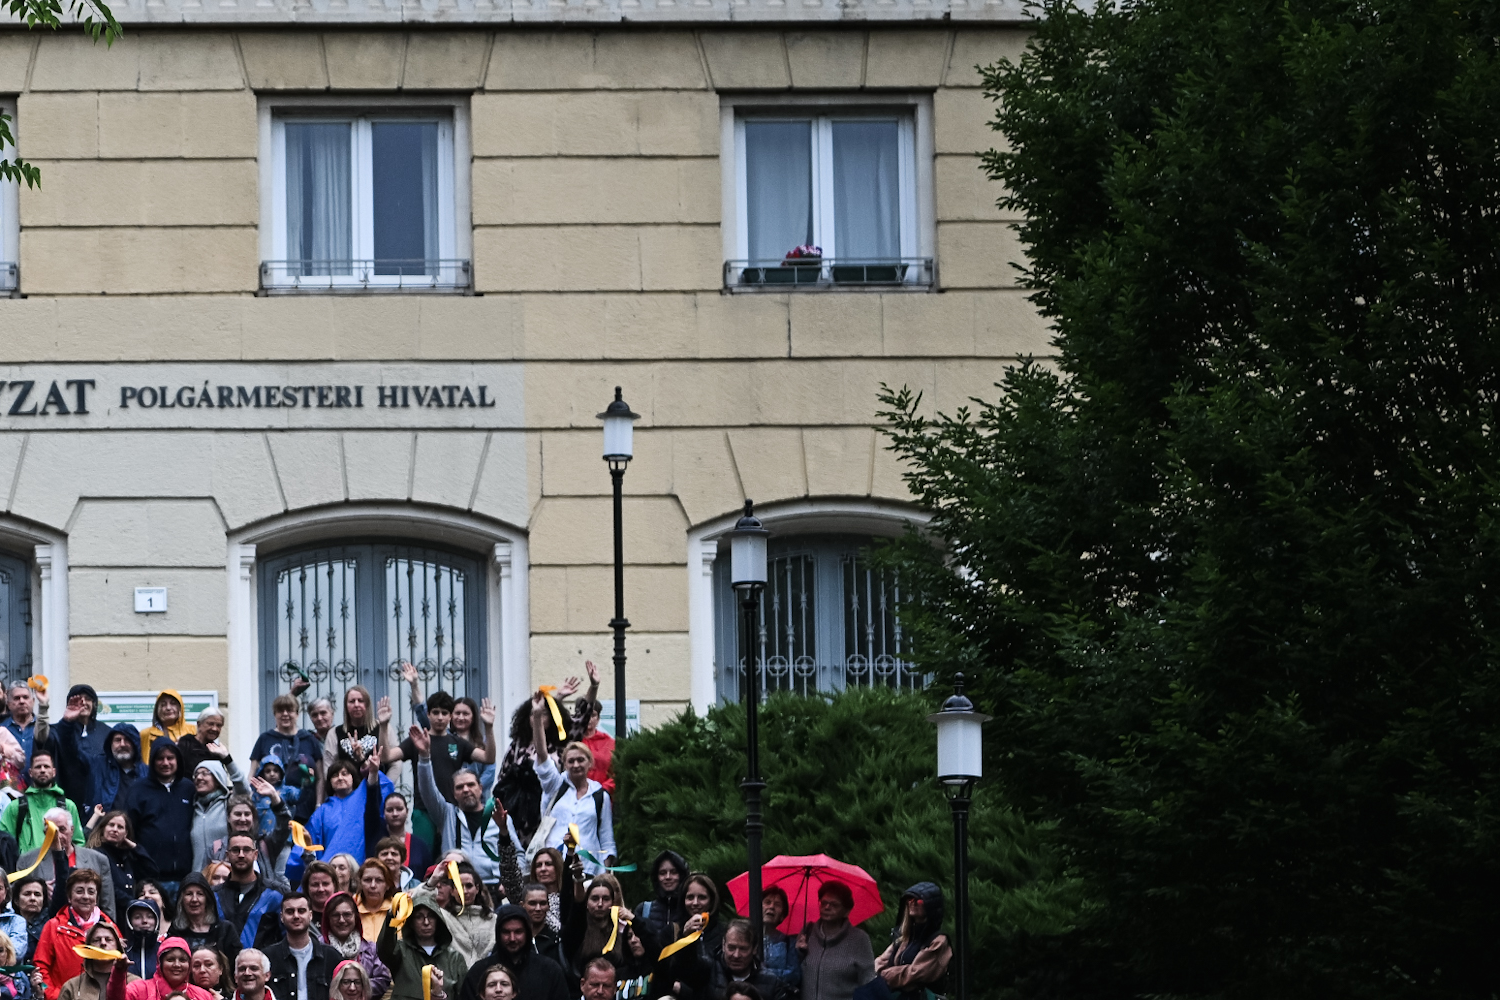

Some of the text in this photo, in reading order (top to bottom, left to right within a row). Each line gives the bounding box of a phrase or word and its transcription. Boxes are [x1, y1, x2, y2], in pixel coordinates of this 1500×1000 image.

[119, 380, 496, 409] POLGÁRMESTERI HIVATAL
[147, 597, 153, 608] 1
